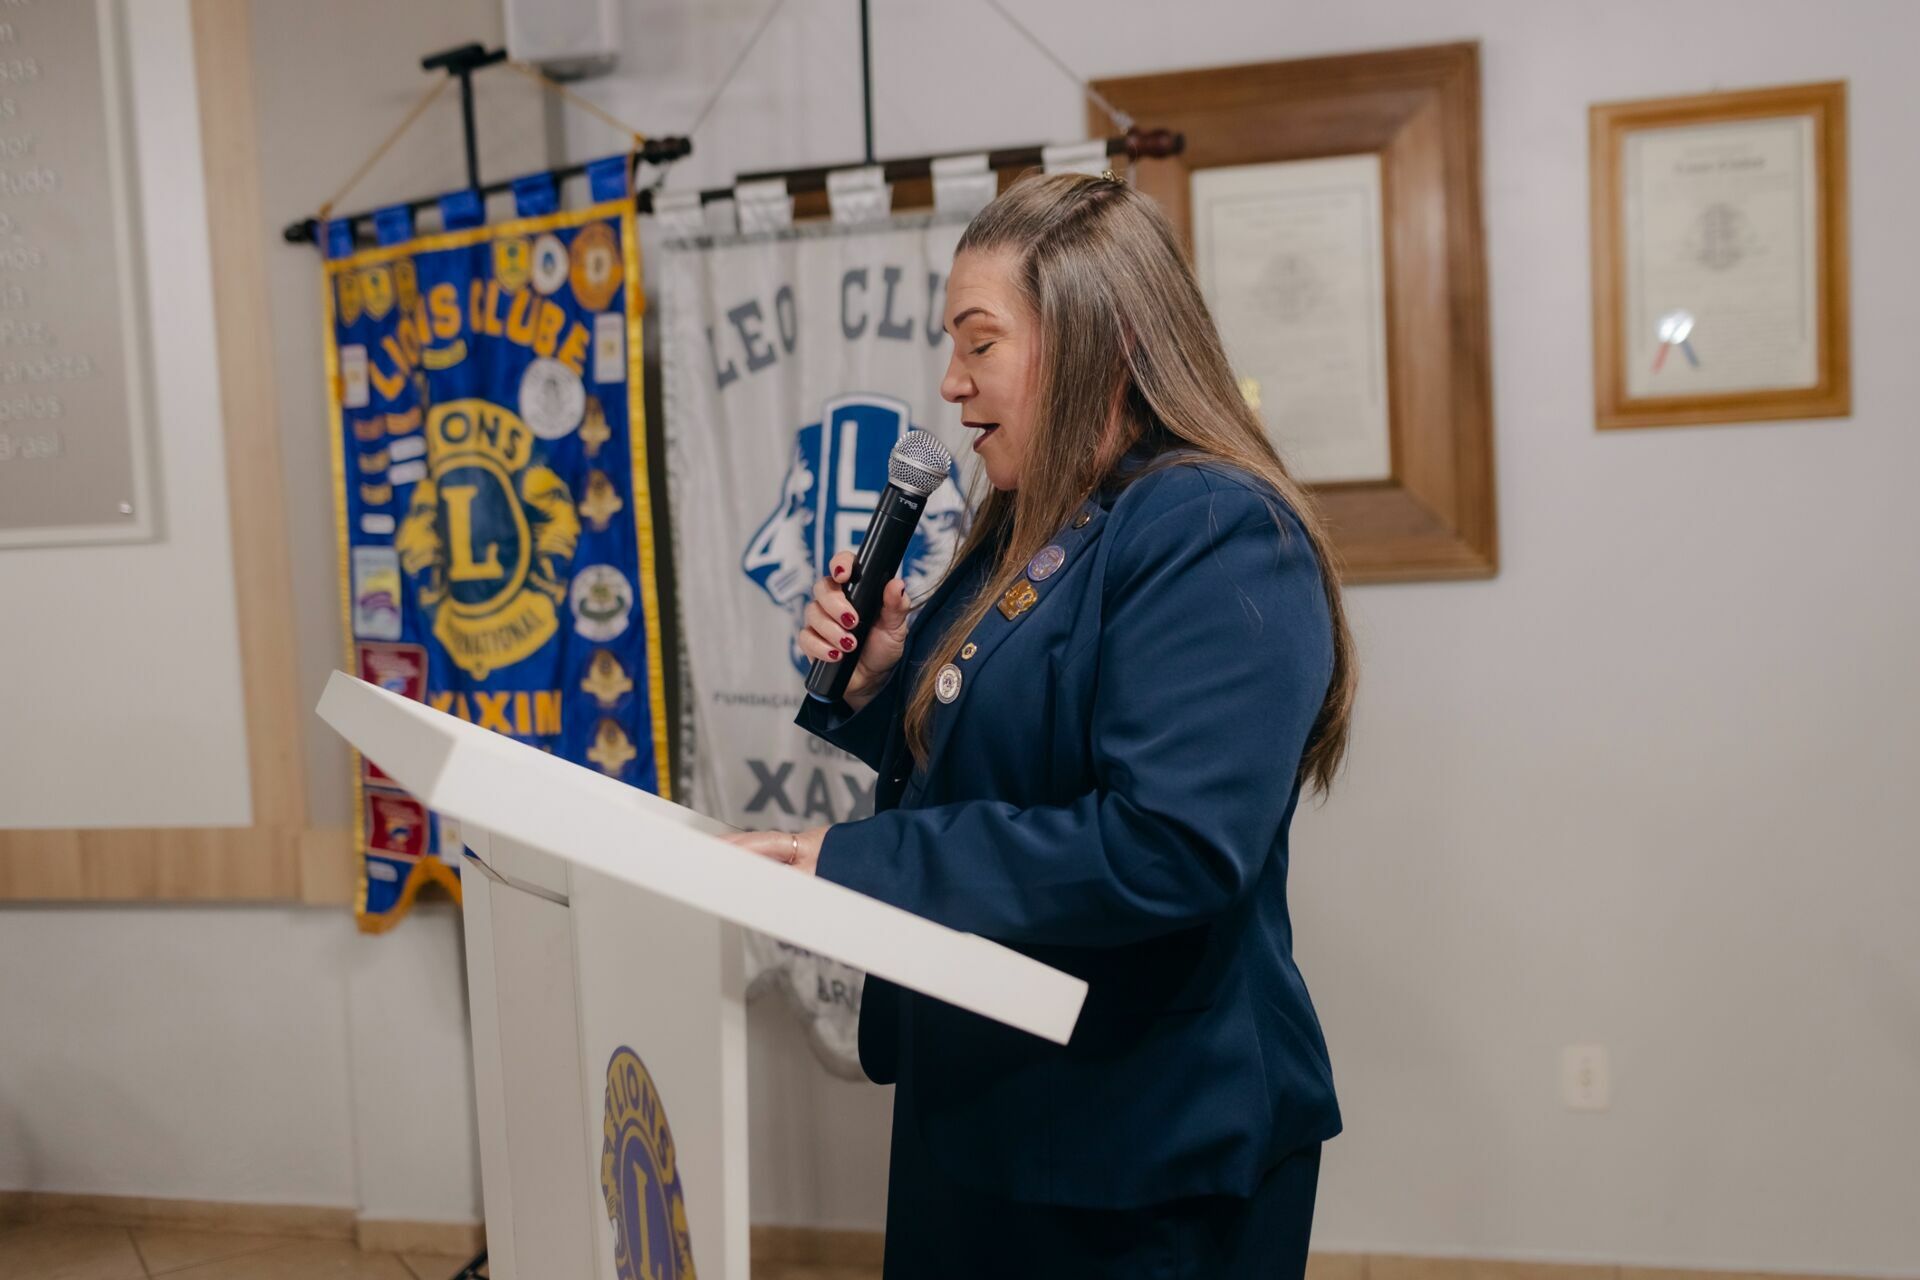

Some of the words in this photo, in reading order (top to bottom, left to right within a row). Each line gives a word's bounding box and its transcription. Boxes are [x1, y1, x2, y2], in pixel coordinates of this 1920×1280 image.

[706, 286, 797, 389] LEO
[841, 266, 948, 347] CLU
[440, 411, 521, 460] ONS
[440, 485, 504, 581] L
[743, 758, 877, 825] XAX
[611, 1062, 669, 1171] LIONS
